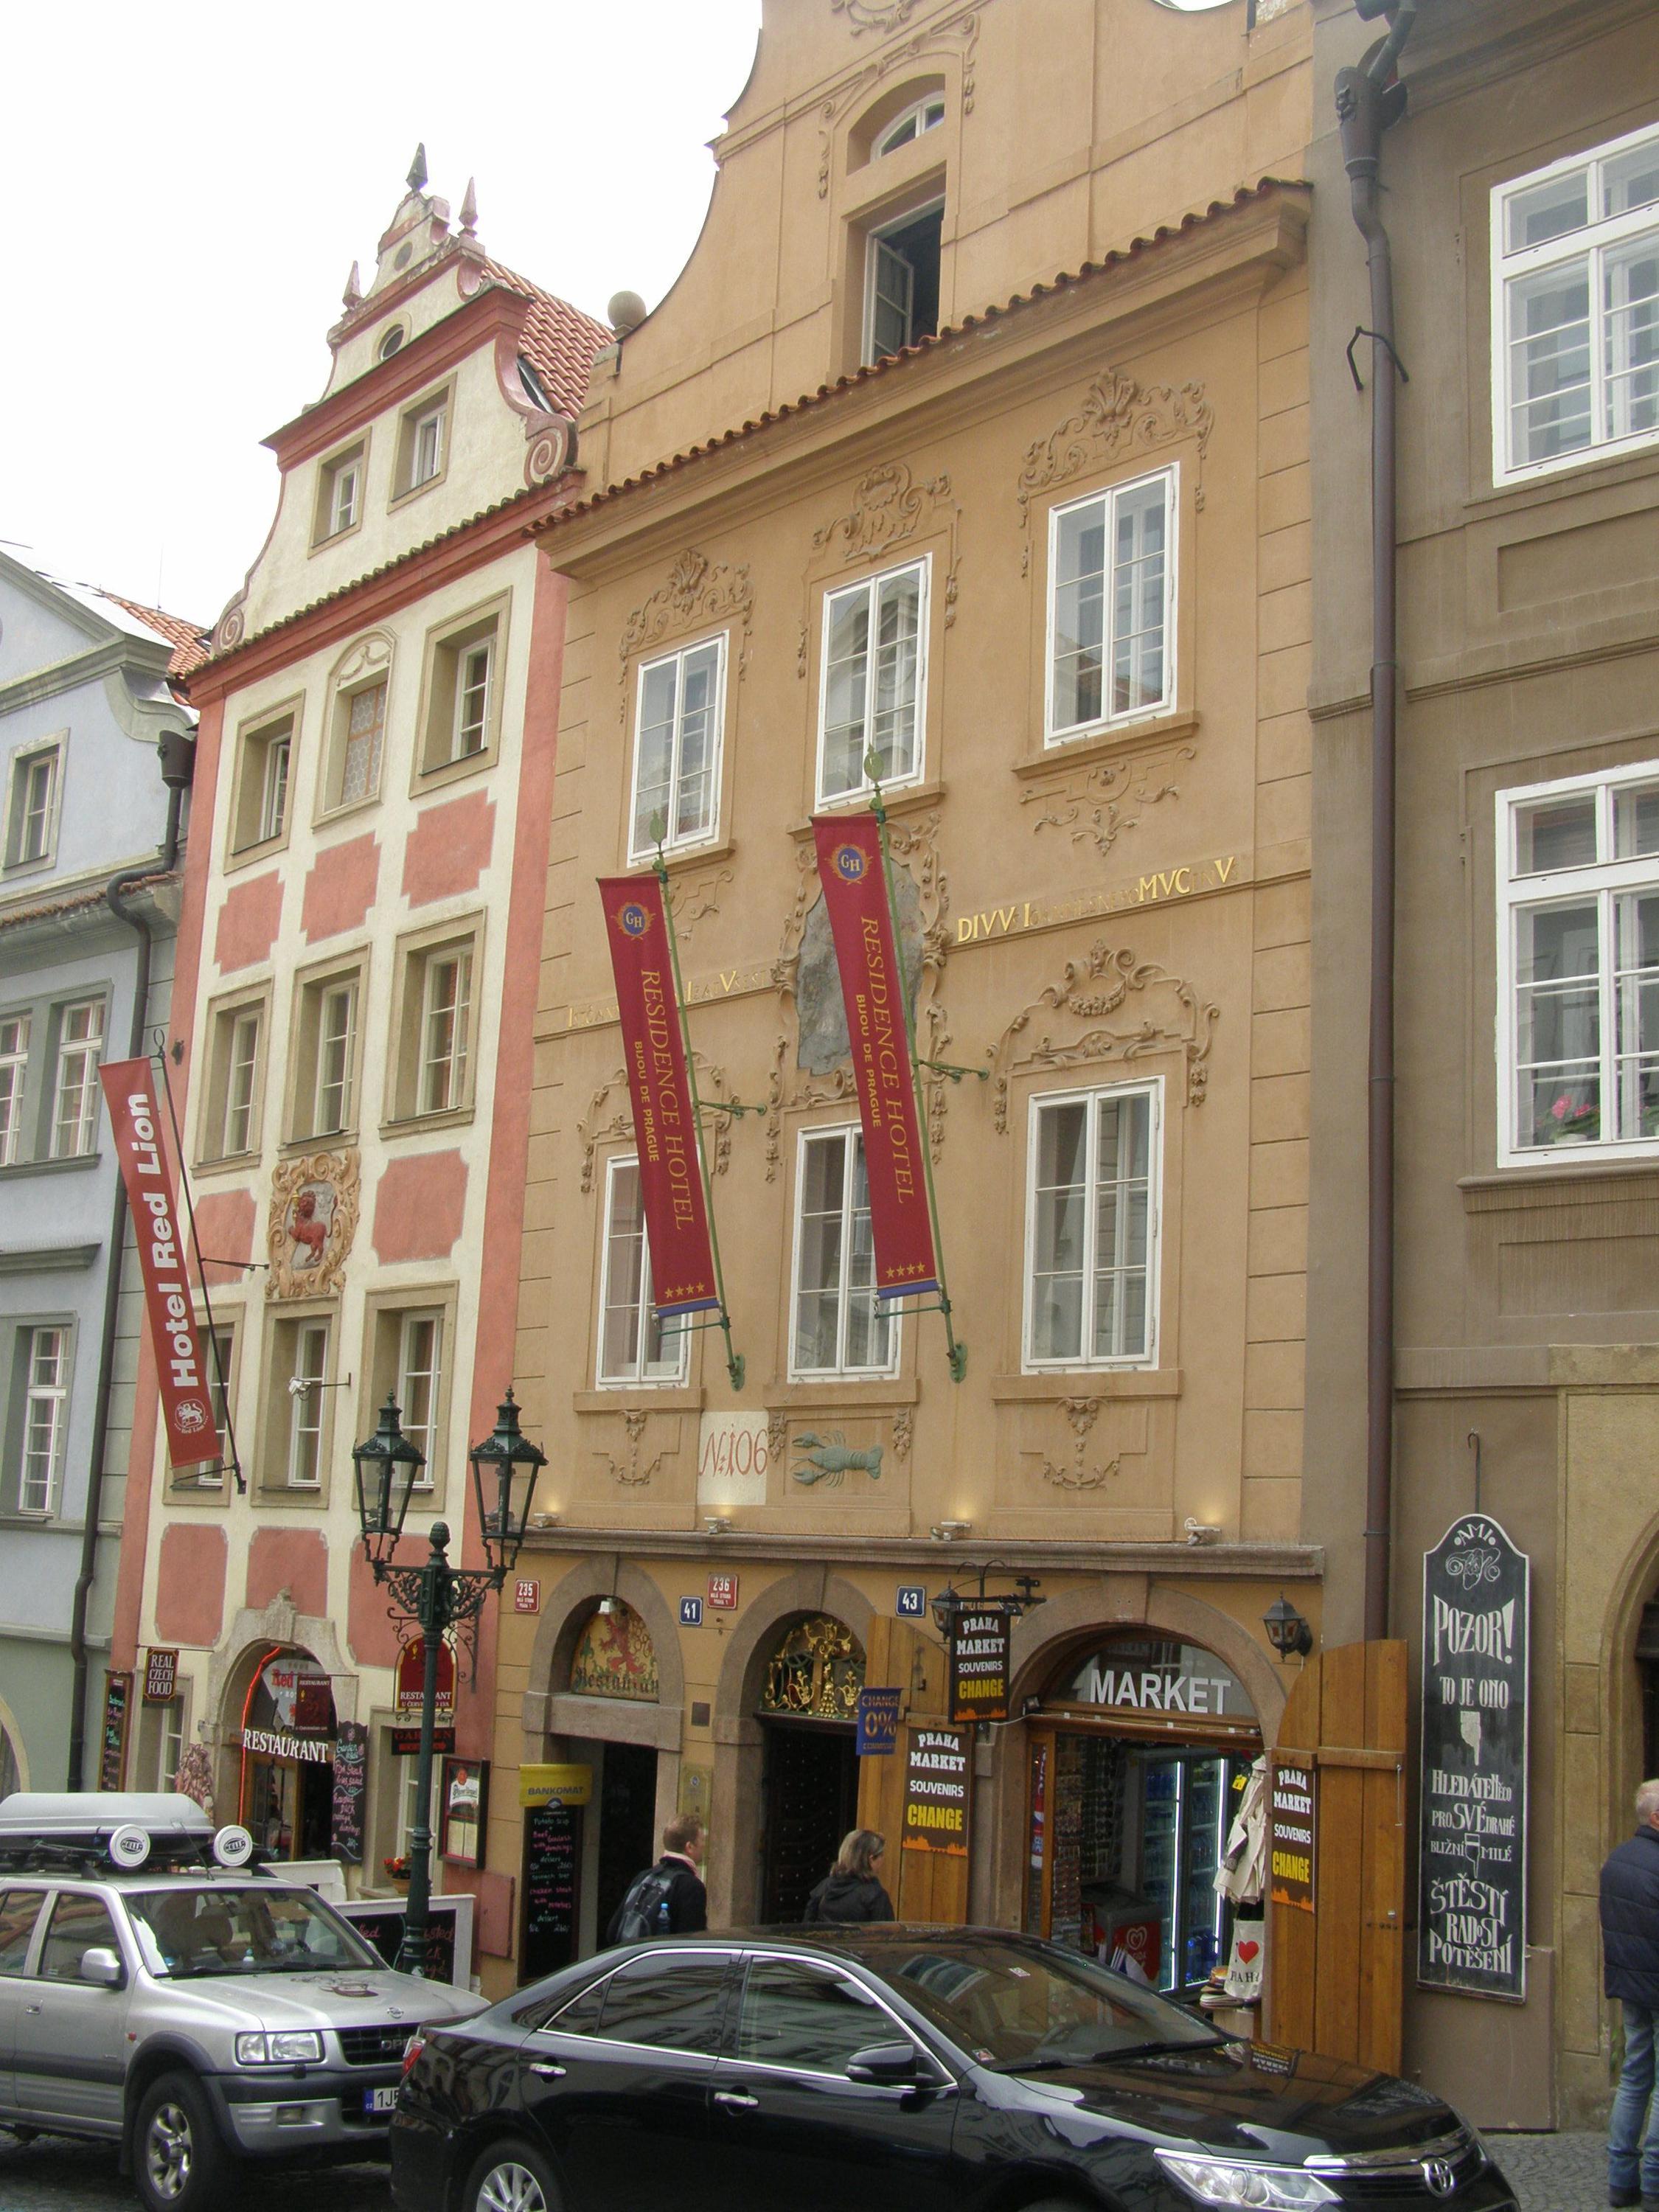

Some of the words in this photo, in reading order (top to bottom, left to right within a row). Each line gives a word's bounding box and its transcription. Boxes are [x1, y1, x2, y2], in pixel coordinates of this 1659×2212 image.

[856, 994, 869, 1036] BIJOU
[634, 1040, 647, 1080] BIJOU
[861, 917, 900, 1089] RESIDENCE
[886, 1097, 914, 1204] HOTEL
[863, 1043, 873, 1062] DE
[640, 1086, 650, 1104] DE
[641, 968, 680, 1126] RESIDENCE
[665, 1134, 694, 1231] HOTEL
[866, 1069, 882, 1127] PRAGUE
[128, 1093, 161, 1175] Lion
[643, 1109, 660, 1163] PRAGUE
[142, 1192, 178, 1268] Red
[158, 1282, 198, 1388] Hotel
[518, 1582, 533, 1596] 235
[713, 1576, 731, 1591] 236
[684, 1600, 697, 1619] 41
[902, 1593, 918, 1610] 43
[962, 1616, 999, 1635] PRAHA
[1433, 1593, 1515, 1667] POZOR!
[956, 1638, 1005, 1655] MARKET
[150, 1654, 174, 1669] REAL
[959, 1660, 1003, 1674] SOUVENIRS
[149, 1669, 173, 1681] CZECH
[147, 1680, 173, 1695] FOOD
[400, 1691, 451, 1700] RESTAANT
[959, 1678, 1004, 1700] CHANGE
[1090, 1669, 1231, 1715] MARKET
[1439, 1676, 1455, 1705] TO
[1459, 1677, 1475, 1707] JE
[1478, 1680, 1509, 1710] ONO
[865, 1711, 897, 1737] 0%
[243, 1728, 329, 1763] RESTAURANT
[918, 1733, 959, 1751] PRAHA
[910, 1751, 966, 1772] MARKET
[528, 1786, 584, 1795] BANKOMAT
[910, 1780, 964, 1798] SOUVENIRS
[1278, 1770, 1307, 1791] PRAHA
[1273, 1791, 1312, 1815] MARKET
[908, 1804, 963, 1831] CHANGE
[1432, 1810, 1453, 1829] PRO
[1453, 1801, 1486, 1834] SVÉ
[1486, 1815, 1515, 1837] DRAHÉ
[1274, 1823, 1312, 1843] SOUVENIRS
[122, 1840, 143, 1851] HELLA
[224, 1840, 246, 1851] HELLA
[1430, 1837, 1465, 1857] BLIŽNÍ
[1481, 1845, 1512, 1862] MILÉ
[1273, 1851, 1310, 1883] CHANGE
[1430, 1873, 1509, 1928] ŠTĚSTÍ
[1429, 1927, 1512, 1975] POTĚŠENÍ
